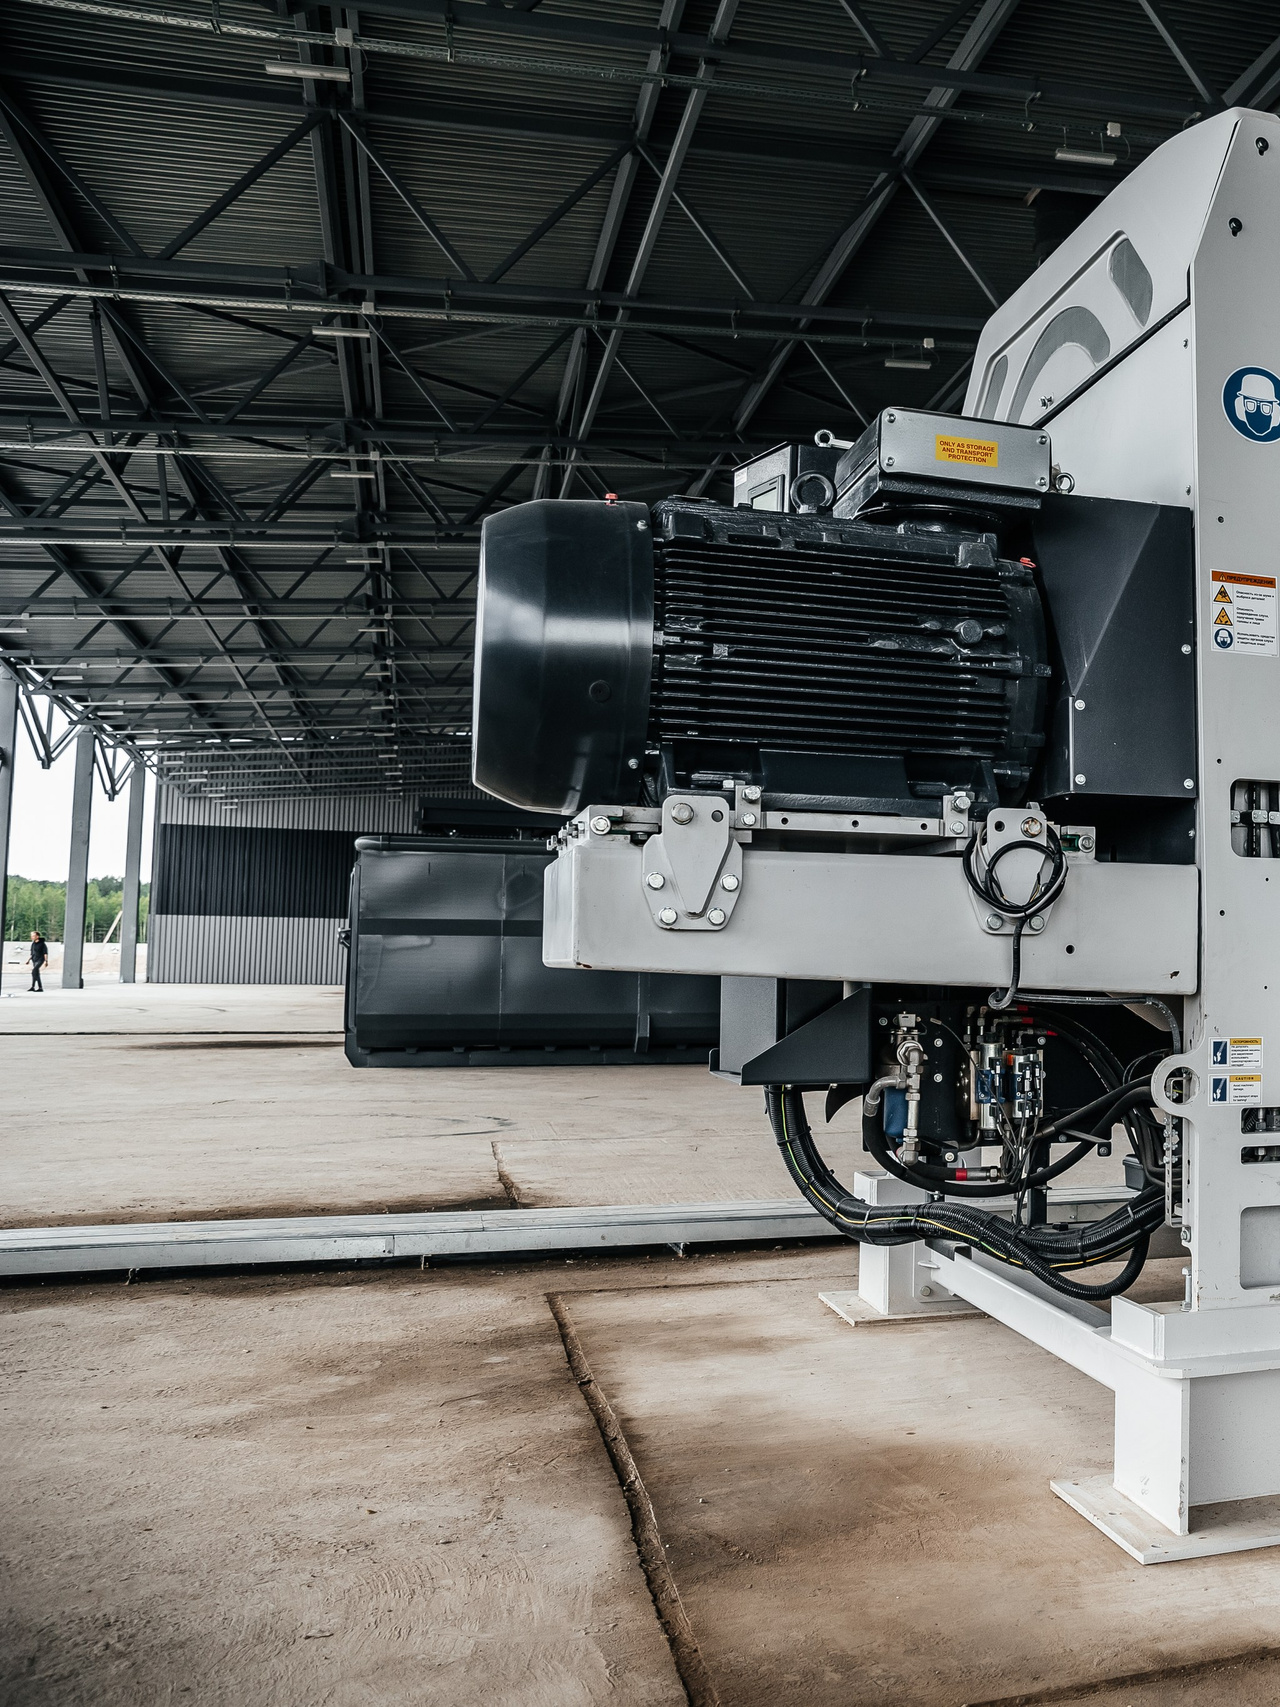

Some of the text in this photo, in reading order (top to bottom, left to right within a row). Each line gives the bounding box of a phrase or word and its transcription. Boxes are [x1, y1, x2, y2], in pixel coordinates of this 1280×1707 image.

[956, 448, 993, 458] TRANSPORT
[966, 444, 995, 452] STORAGE
[948, 453, 987, 463] PROTECTION
